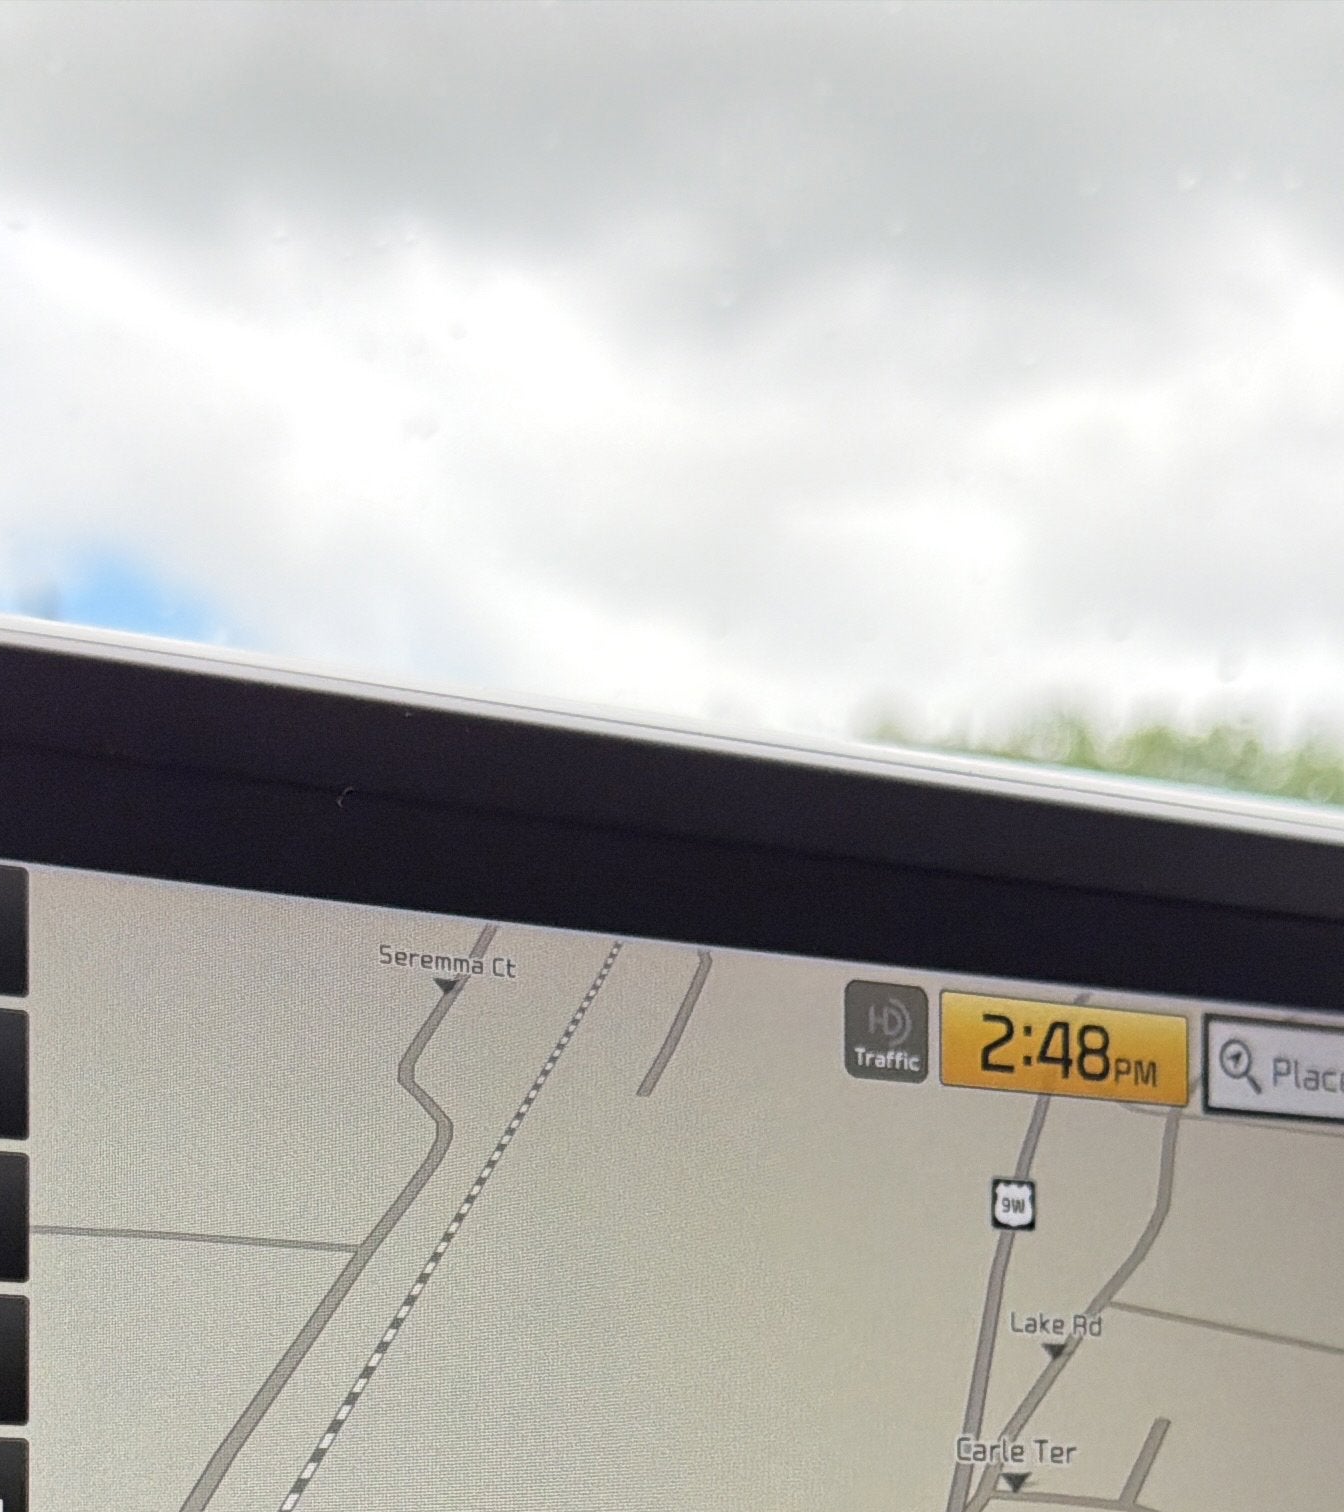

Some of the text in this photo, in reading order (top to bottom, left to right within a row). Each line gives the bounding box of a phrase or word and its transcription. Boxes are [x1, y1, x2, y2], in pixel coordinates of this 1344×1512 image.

[379, 944, 516, 978] Seremma Ct
[854, 1046, 922, 1073] Traffic
[1001, 1197, 1026, 1214] 9W
[1010, 1311, 1102, 1337] Lake Rd
[956, 1437, 1077, 1464] Carle Ter
